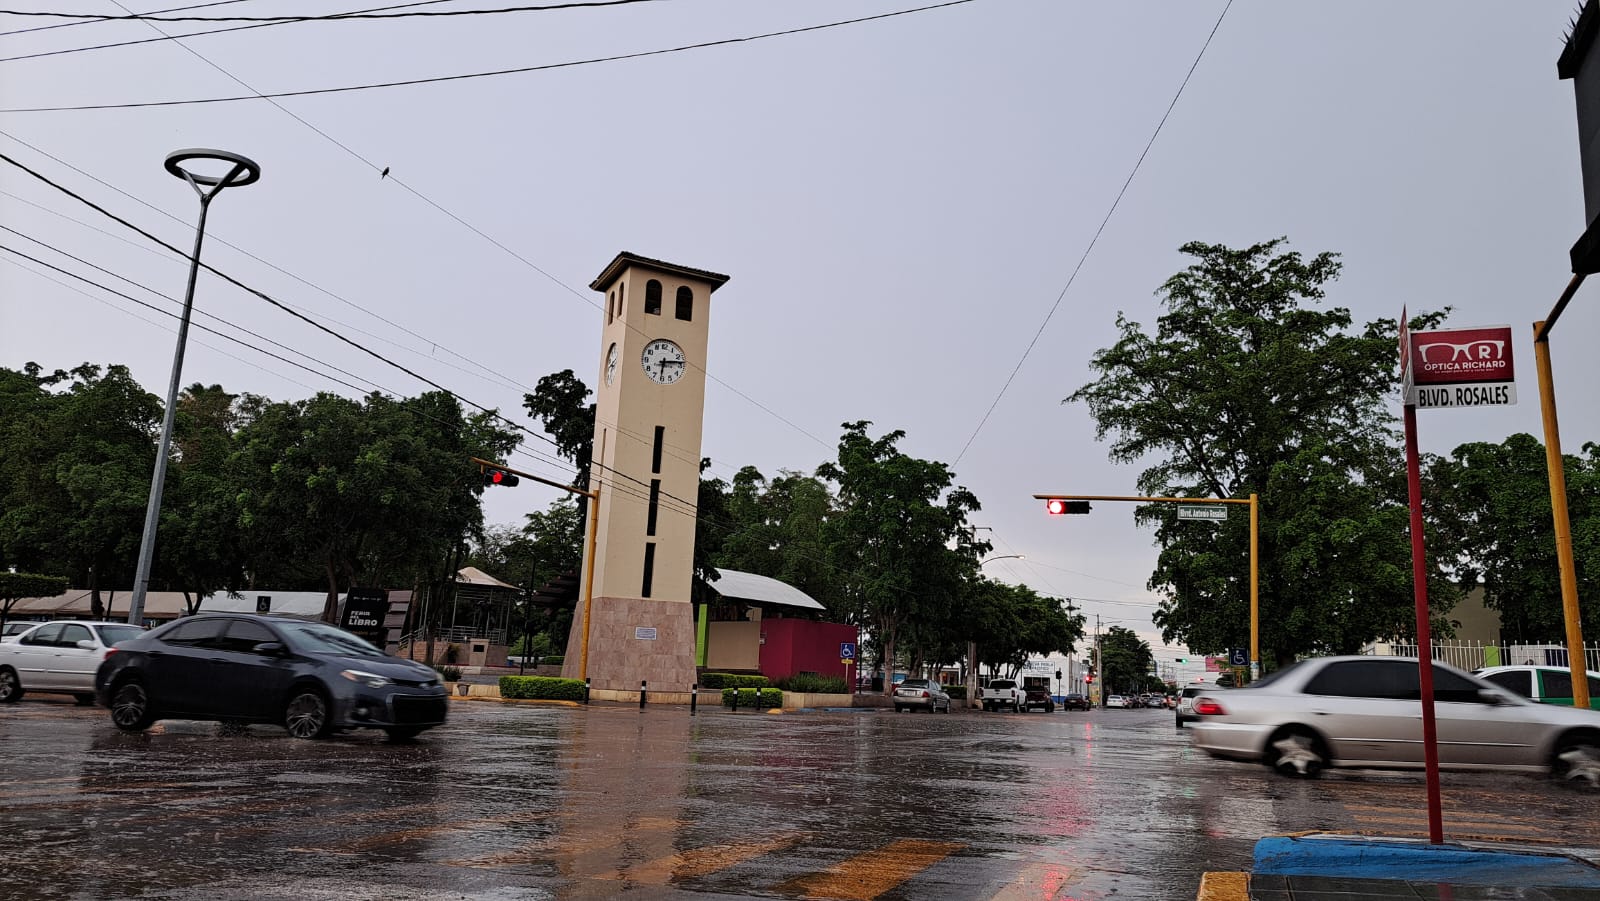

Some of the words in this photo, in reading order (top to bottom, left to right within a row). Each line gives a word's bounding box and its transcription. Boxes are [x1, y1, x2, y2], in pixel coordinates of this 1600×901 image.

[1478, 345, 1491, 359] R
[1462, 360, 1506, 369] RICHARD
[1419, 389, 1453, 407] BLVD.
[1456, 385, 1508, 406] ROSALES
